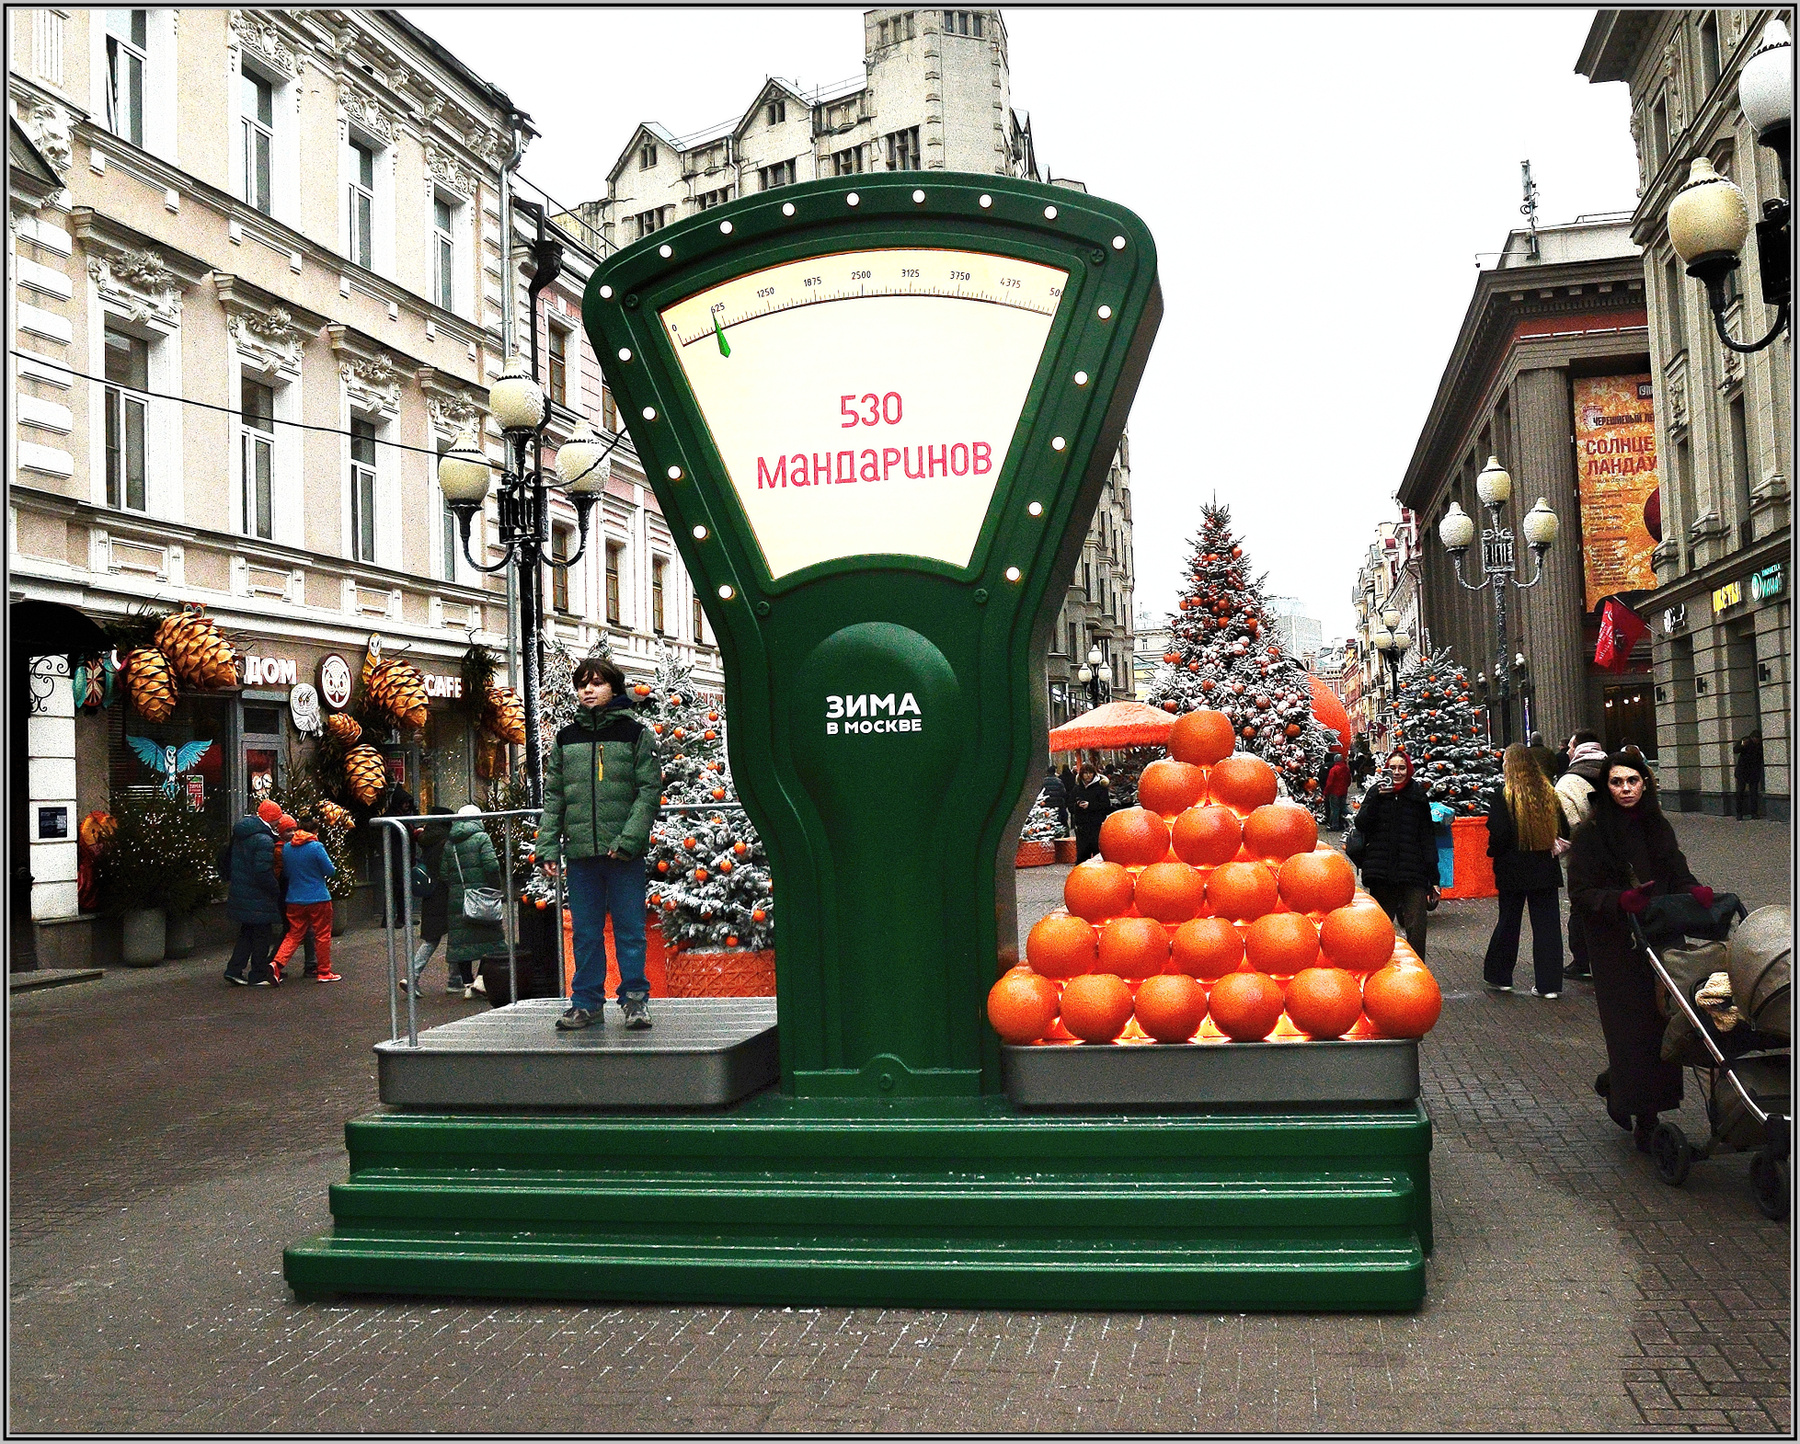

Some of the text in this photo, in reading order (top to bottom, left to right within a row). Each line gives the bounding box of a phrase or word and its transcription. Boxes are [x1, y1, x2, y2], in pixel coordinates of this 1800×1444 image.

[710, 302, 726, 314] 625
[756, 286, 775, 298] 1250
[803, 276, 822, 287] 1875
[851, 270, 872, 280] 2500
[901, 269, 920, 278] 3125
[950, 270, 971, 281] 3750
[1000, 277, 1021, 289] 4375
[1049, 287, 1063, 297] 50
[840, 391, 903, 428] 530
[1644, 413, 1655, 423] ЛЕ
[1586, 435, 1654, 456] СОЛНЦЕ
[1586, 455, 1658, 477] ЛАНДАУ
[1712, 580, 1741, 617] ЦВЕТЫ
[244, 656, 298, 686] ДОМ
[423, 674, 462, 698] CAFE
[825, 692, 922, 719] ЗИМА
[826, 718, 923, 735] В МОСКВЕ
